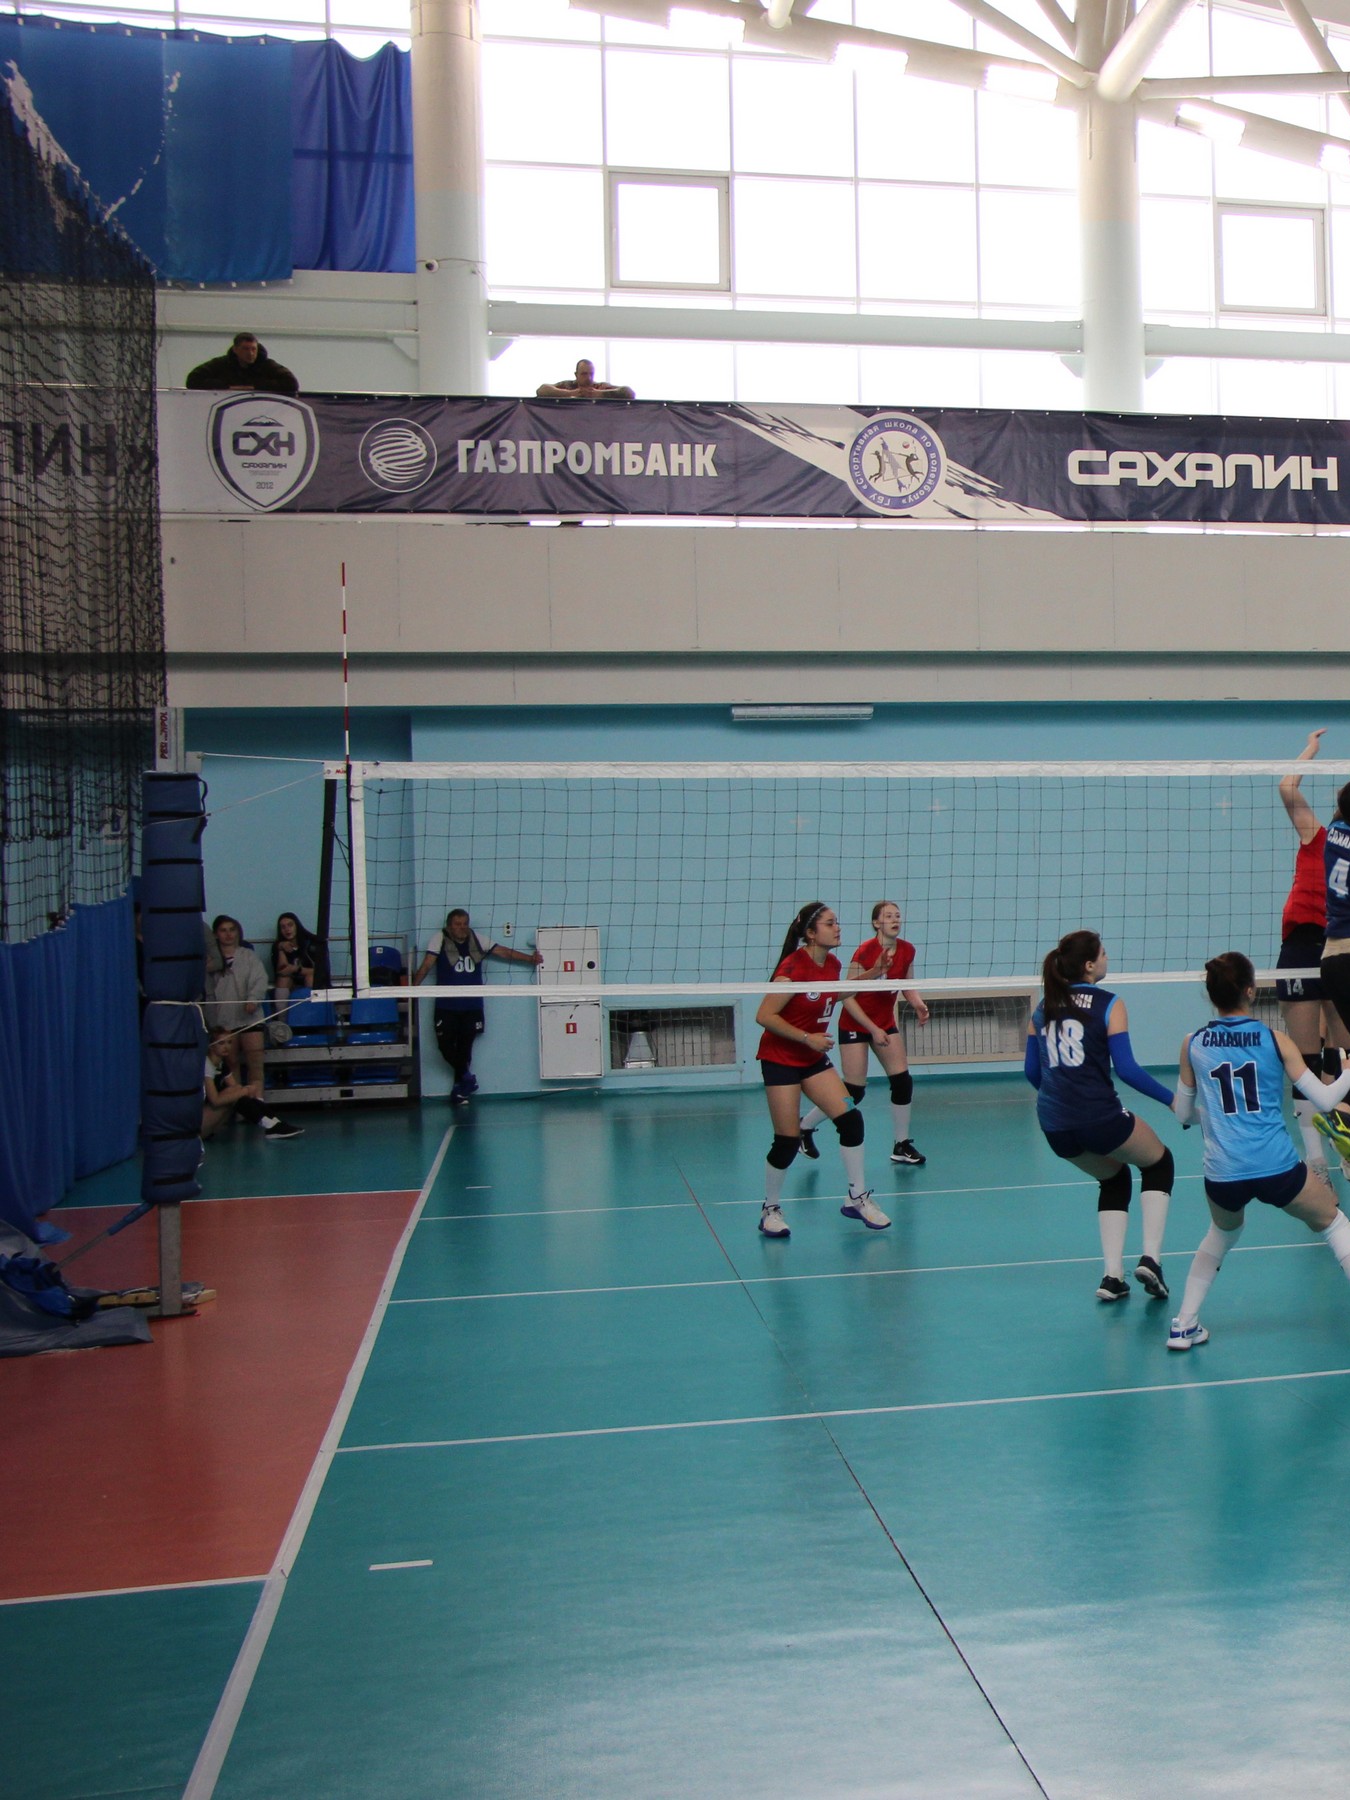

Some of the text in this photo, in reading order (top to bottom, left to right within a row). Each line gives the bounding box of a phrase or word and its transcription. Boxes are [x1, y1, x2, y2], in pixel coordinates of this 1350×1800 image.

[457, 439, 718, 477] ГАЗПРОМБАНК
[920, 435, 932, 448] по
[256, 481, 274, 490] 2012
[1067, 449, 1339, 492] САХАЛИН
[1328, 858, 1350, 898] 4
[822, 997, 832, 1017] 6
[1041, 1018, 1086, 1068] 18
[1201, 1030, 1262, 1048] САХАЛИН
[1210, 1060, 1262, 1116] 11
